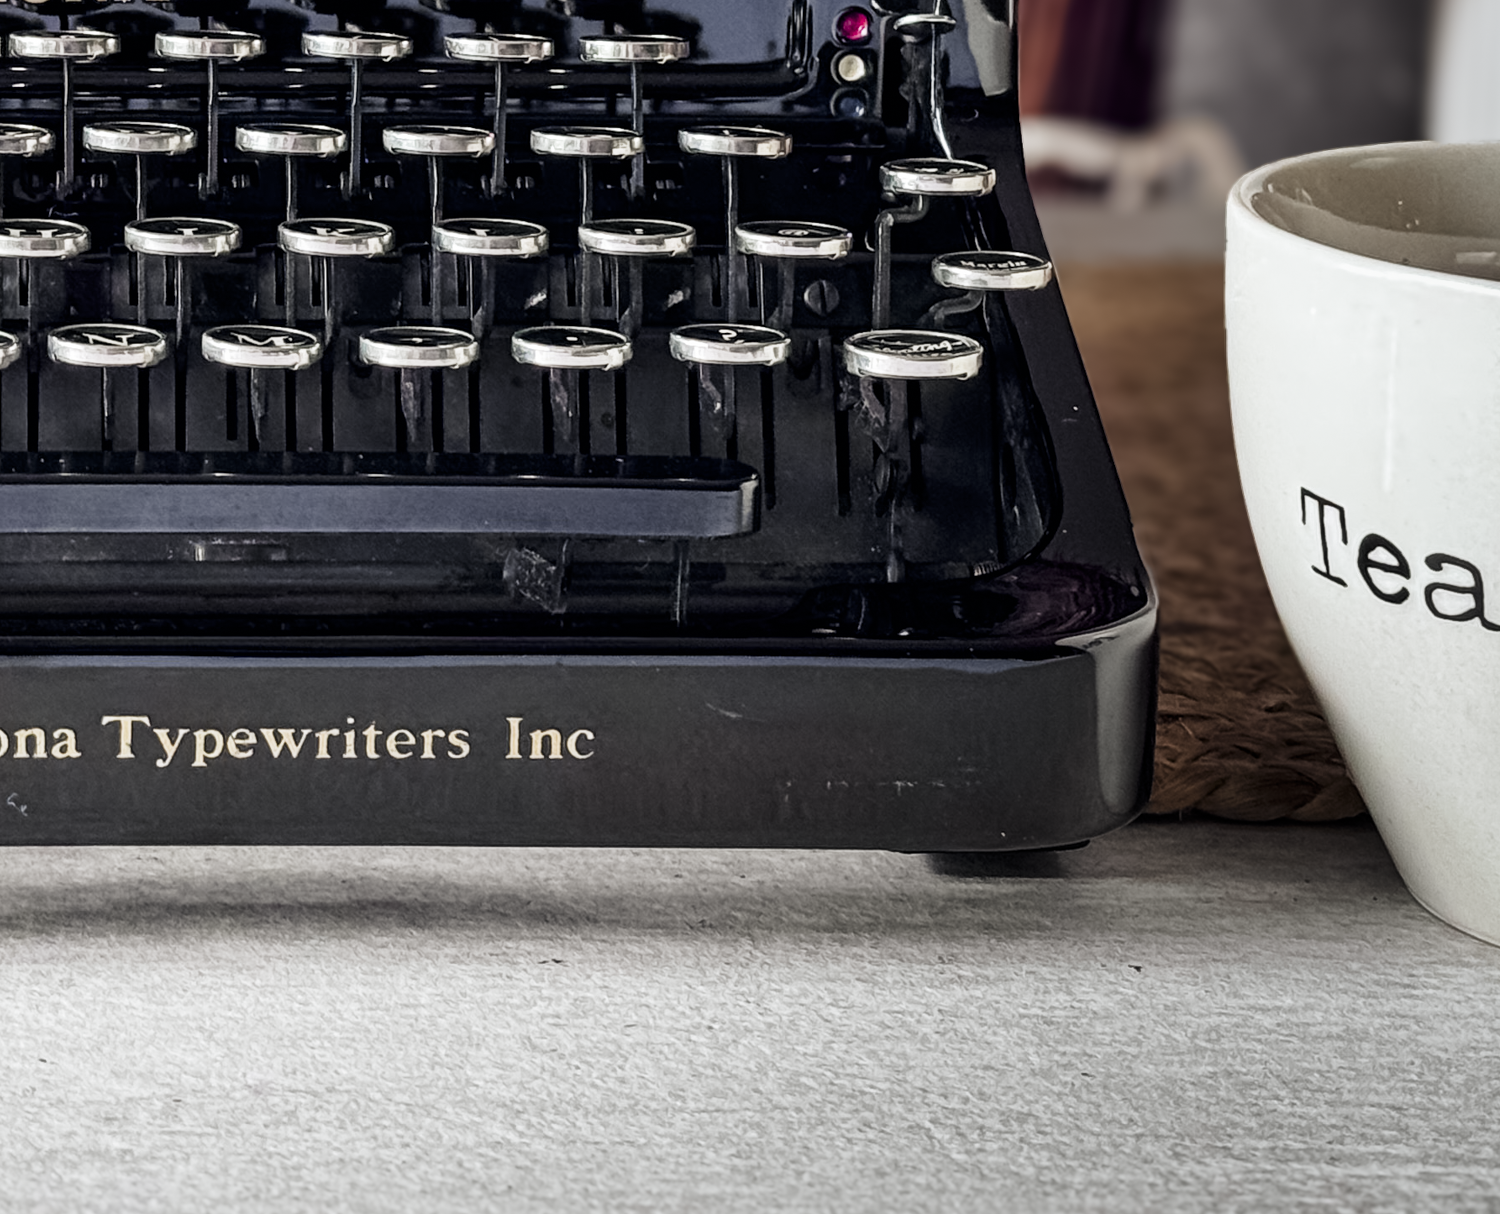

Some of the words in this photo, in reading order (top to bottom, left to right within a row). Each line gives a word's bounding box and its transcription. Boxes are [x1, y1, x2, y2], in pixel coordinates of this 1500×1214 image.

[1299, 486, 1500, 633] Tea
[101, 714, 471, 768] Typewriters
[506, 715, 595, 760] Inc
